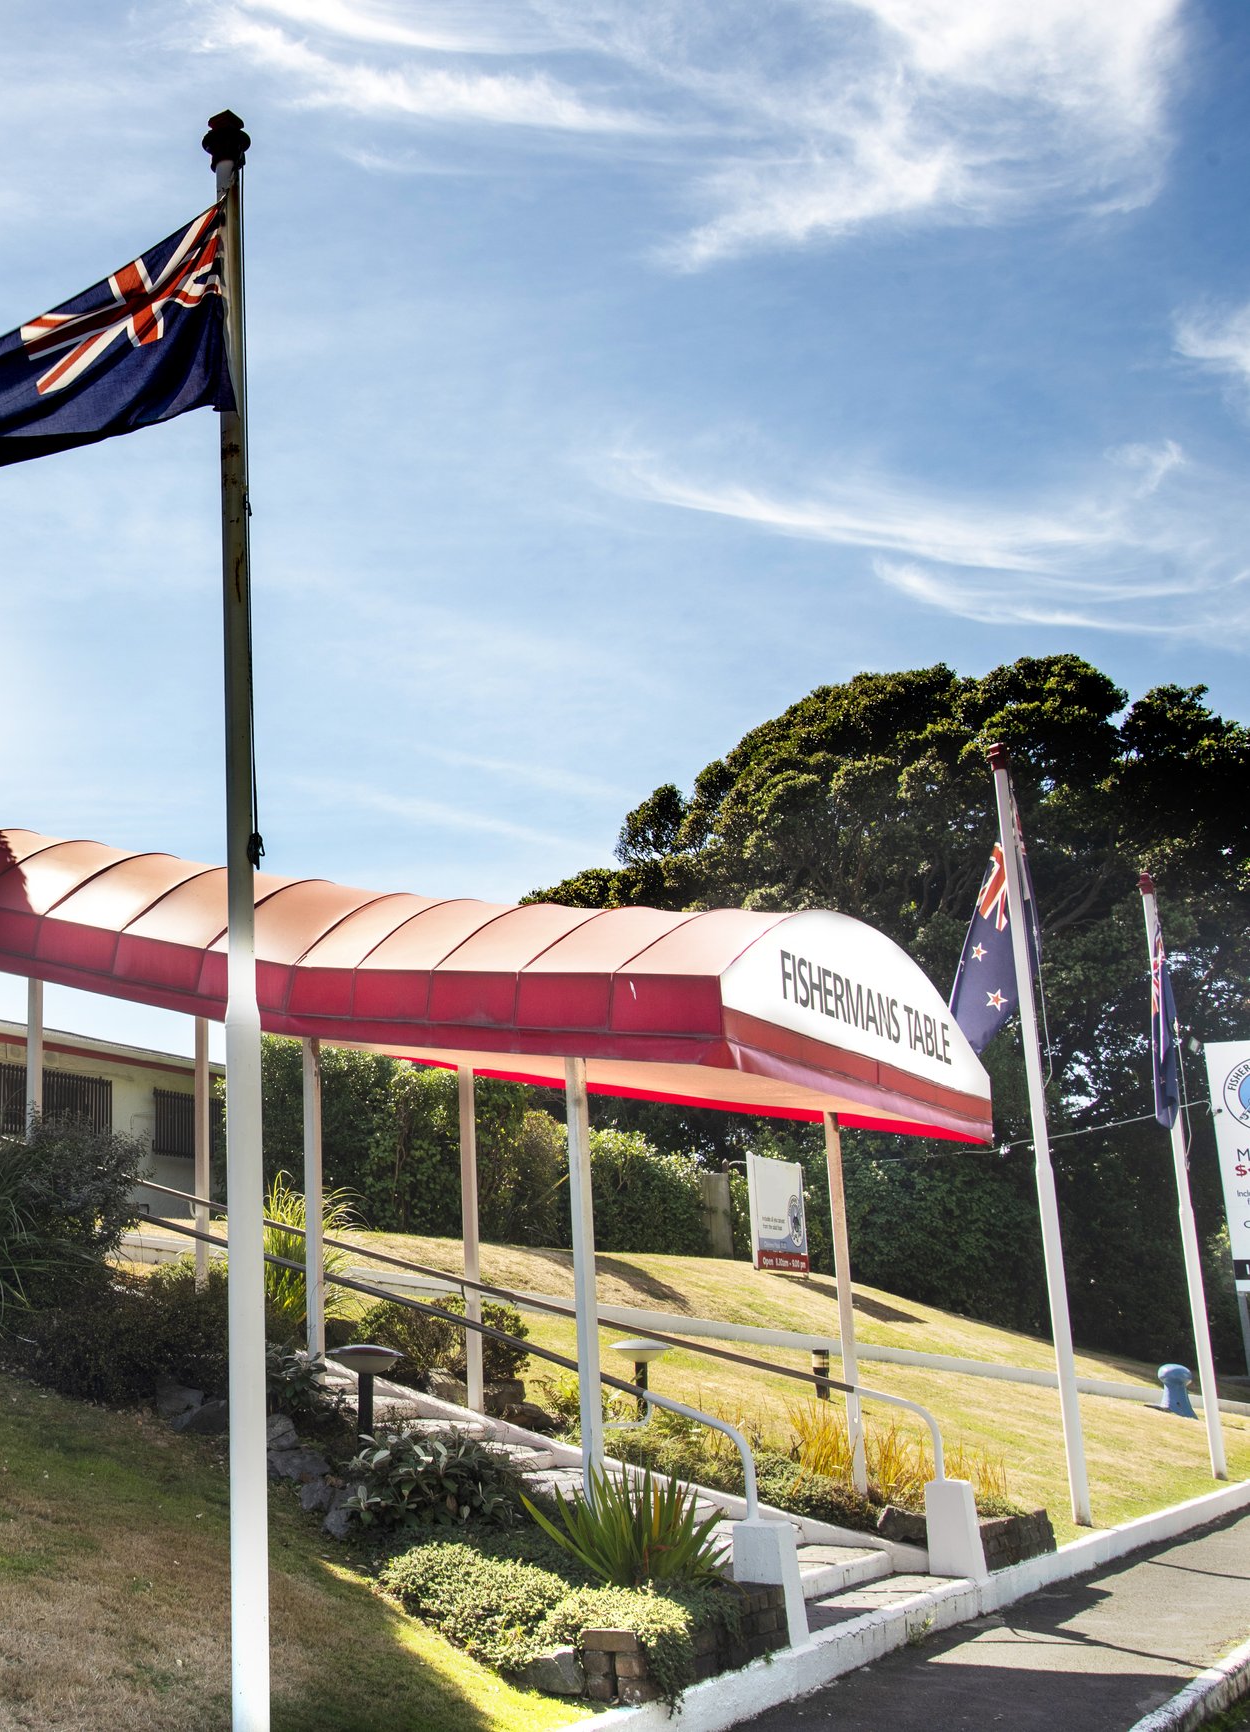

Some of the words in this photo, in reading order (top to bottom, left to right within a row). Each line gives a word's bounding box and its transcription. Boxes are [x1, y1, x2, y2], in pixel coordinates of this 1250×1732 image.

[780, 949, 900, 1044] FISHERMANS
[903, 1004, 952, 1065] TABLE
[762, 1256, 774, 1268] Open
